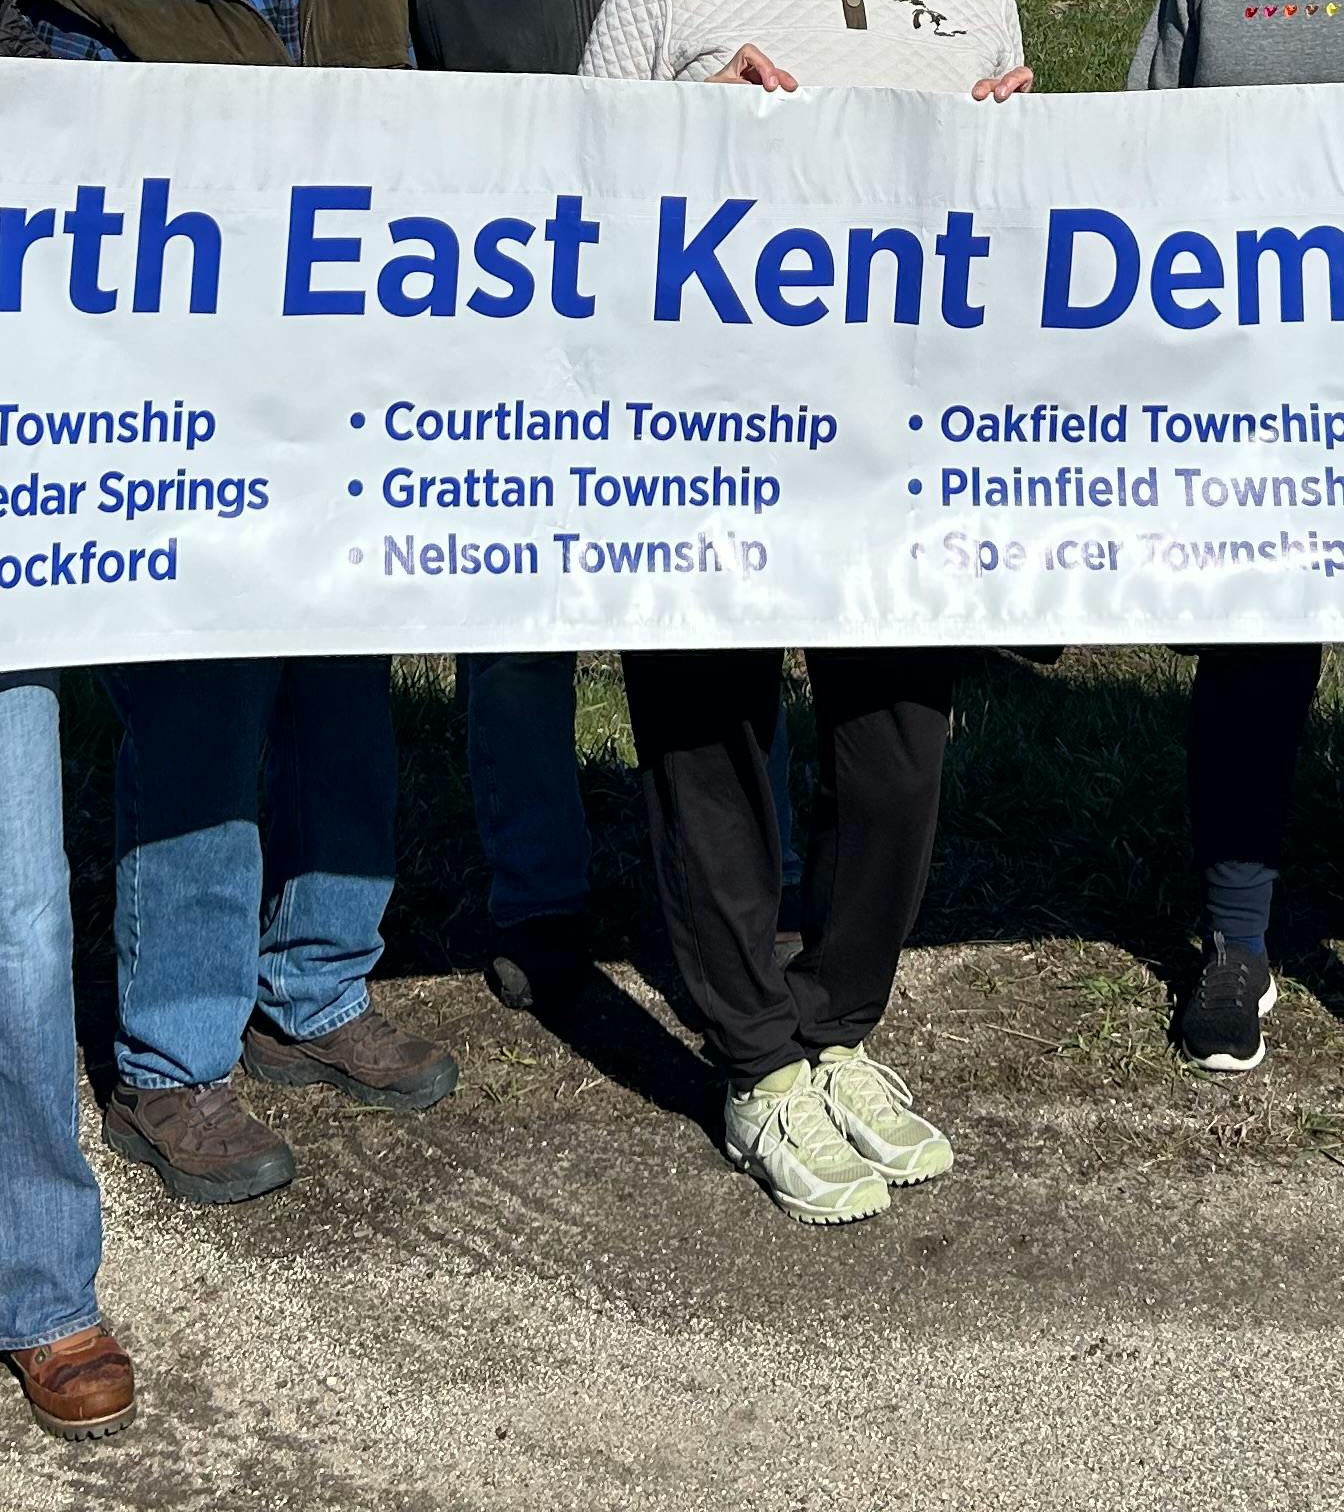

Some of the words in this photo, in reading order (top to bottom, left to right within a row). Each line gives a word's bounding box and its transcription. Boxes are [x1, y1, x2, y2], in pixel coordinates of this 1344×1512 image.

[281, 185, 600, 321] East
[653, 196, 990, 329] Kent
[384, 400, 610, 442] Courtland
[625, 402, 838, 451] Township
[941, 404, 1127, 445] Oakfield
[97, 468, 269, 520] Springs
[382, 467, 554, 511] Grattan
[569, 466, 780, 512] Township
[942, 466, 1157, 507] Plainfield
[384, 533, 538, 576] Nelson
